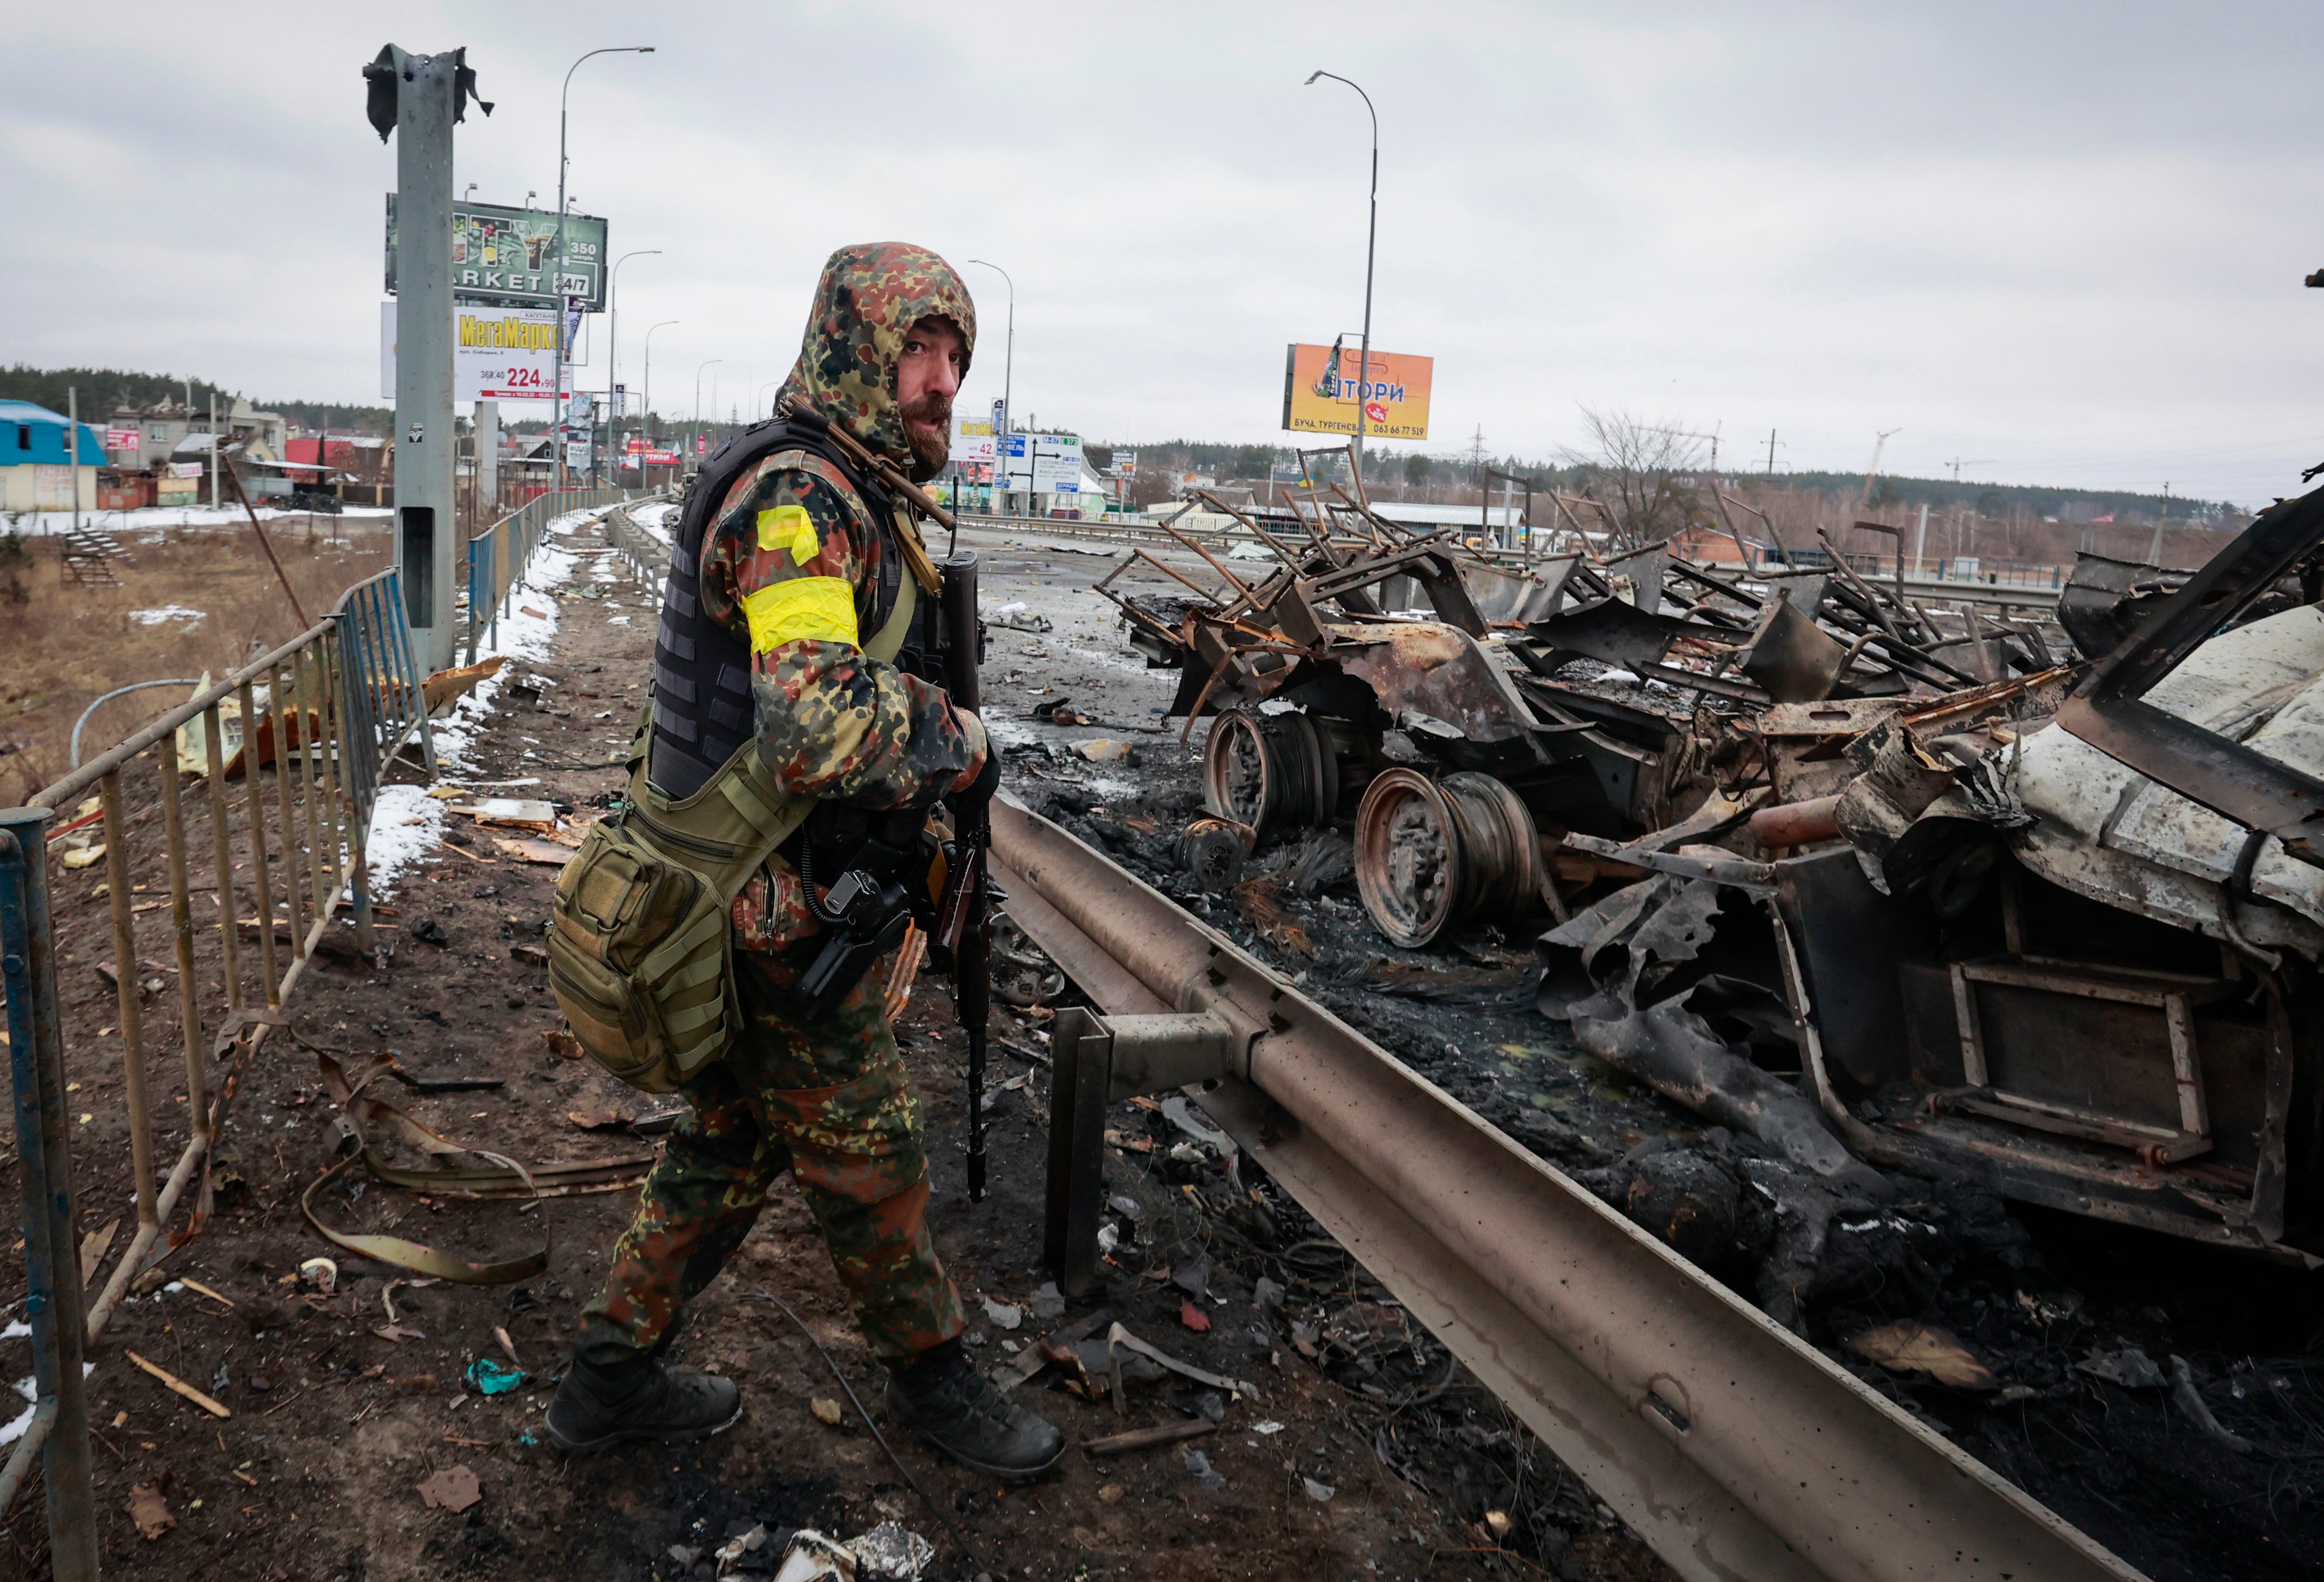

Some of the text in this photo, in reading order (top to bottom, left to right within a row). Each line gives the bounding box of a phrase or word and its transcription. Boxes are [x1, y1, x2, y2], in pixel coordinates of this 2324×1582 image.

[453, 213, 558, 271] ITY
[570, 242, 597, 255] 350
[453, 269, 541, 291] RKET
[1374, 425, 1388, 433] 063
[1402, 427, 1410, 435] 77
[1412, 427, 1425, 436] 519
